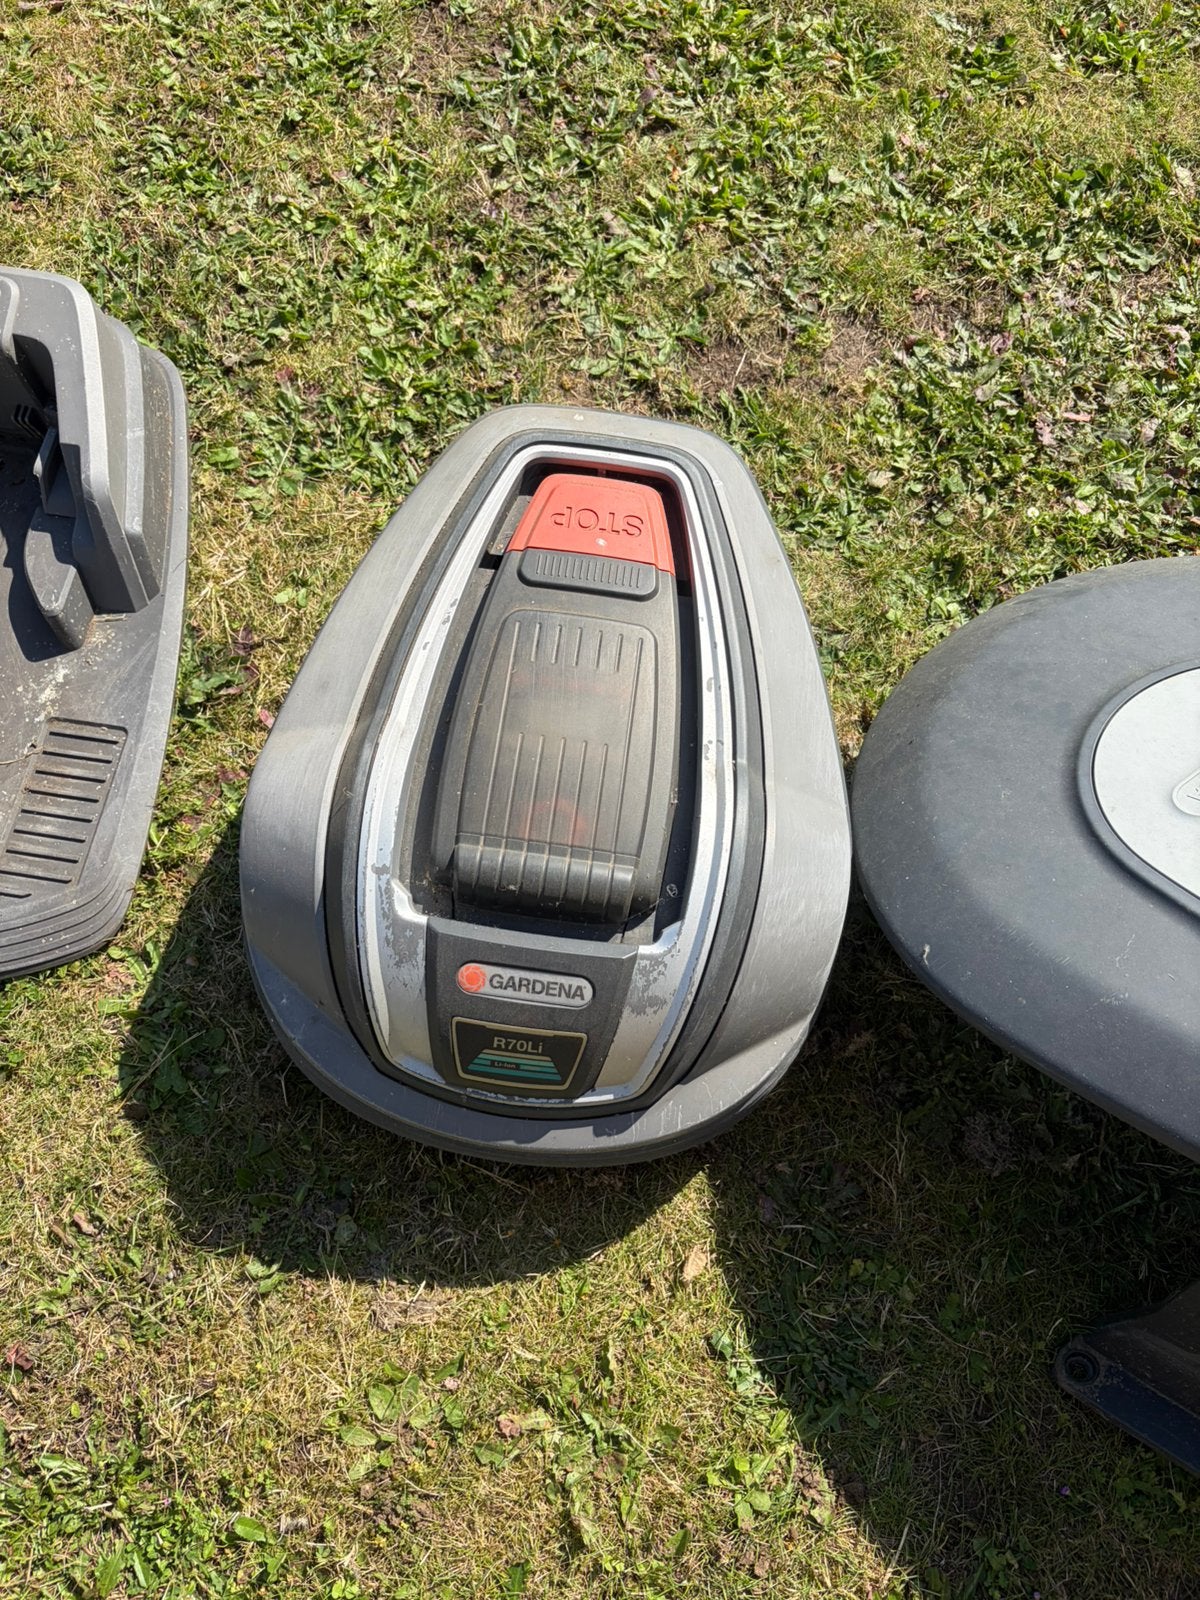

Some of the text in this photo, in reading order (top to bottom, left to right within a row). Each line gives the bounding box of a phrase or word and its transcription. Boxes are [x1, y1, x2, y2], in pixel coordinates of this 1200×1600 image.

[551, 506, 645, 538] STOP
[488, 973, 586, 1001] GARDENA
[492, 1036, 543, 1054] R70Li
